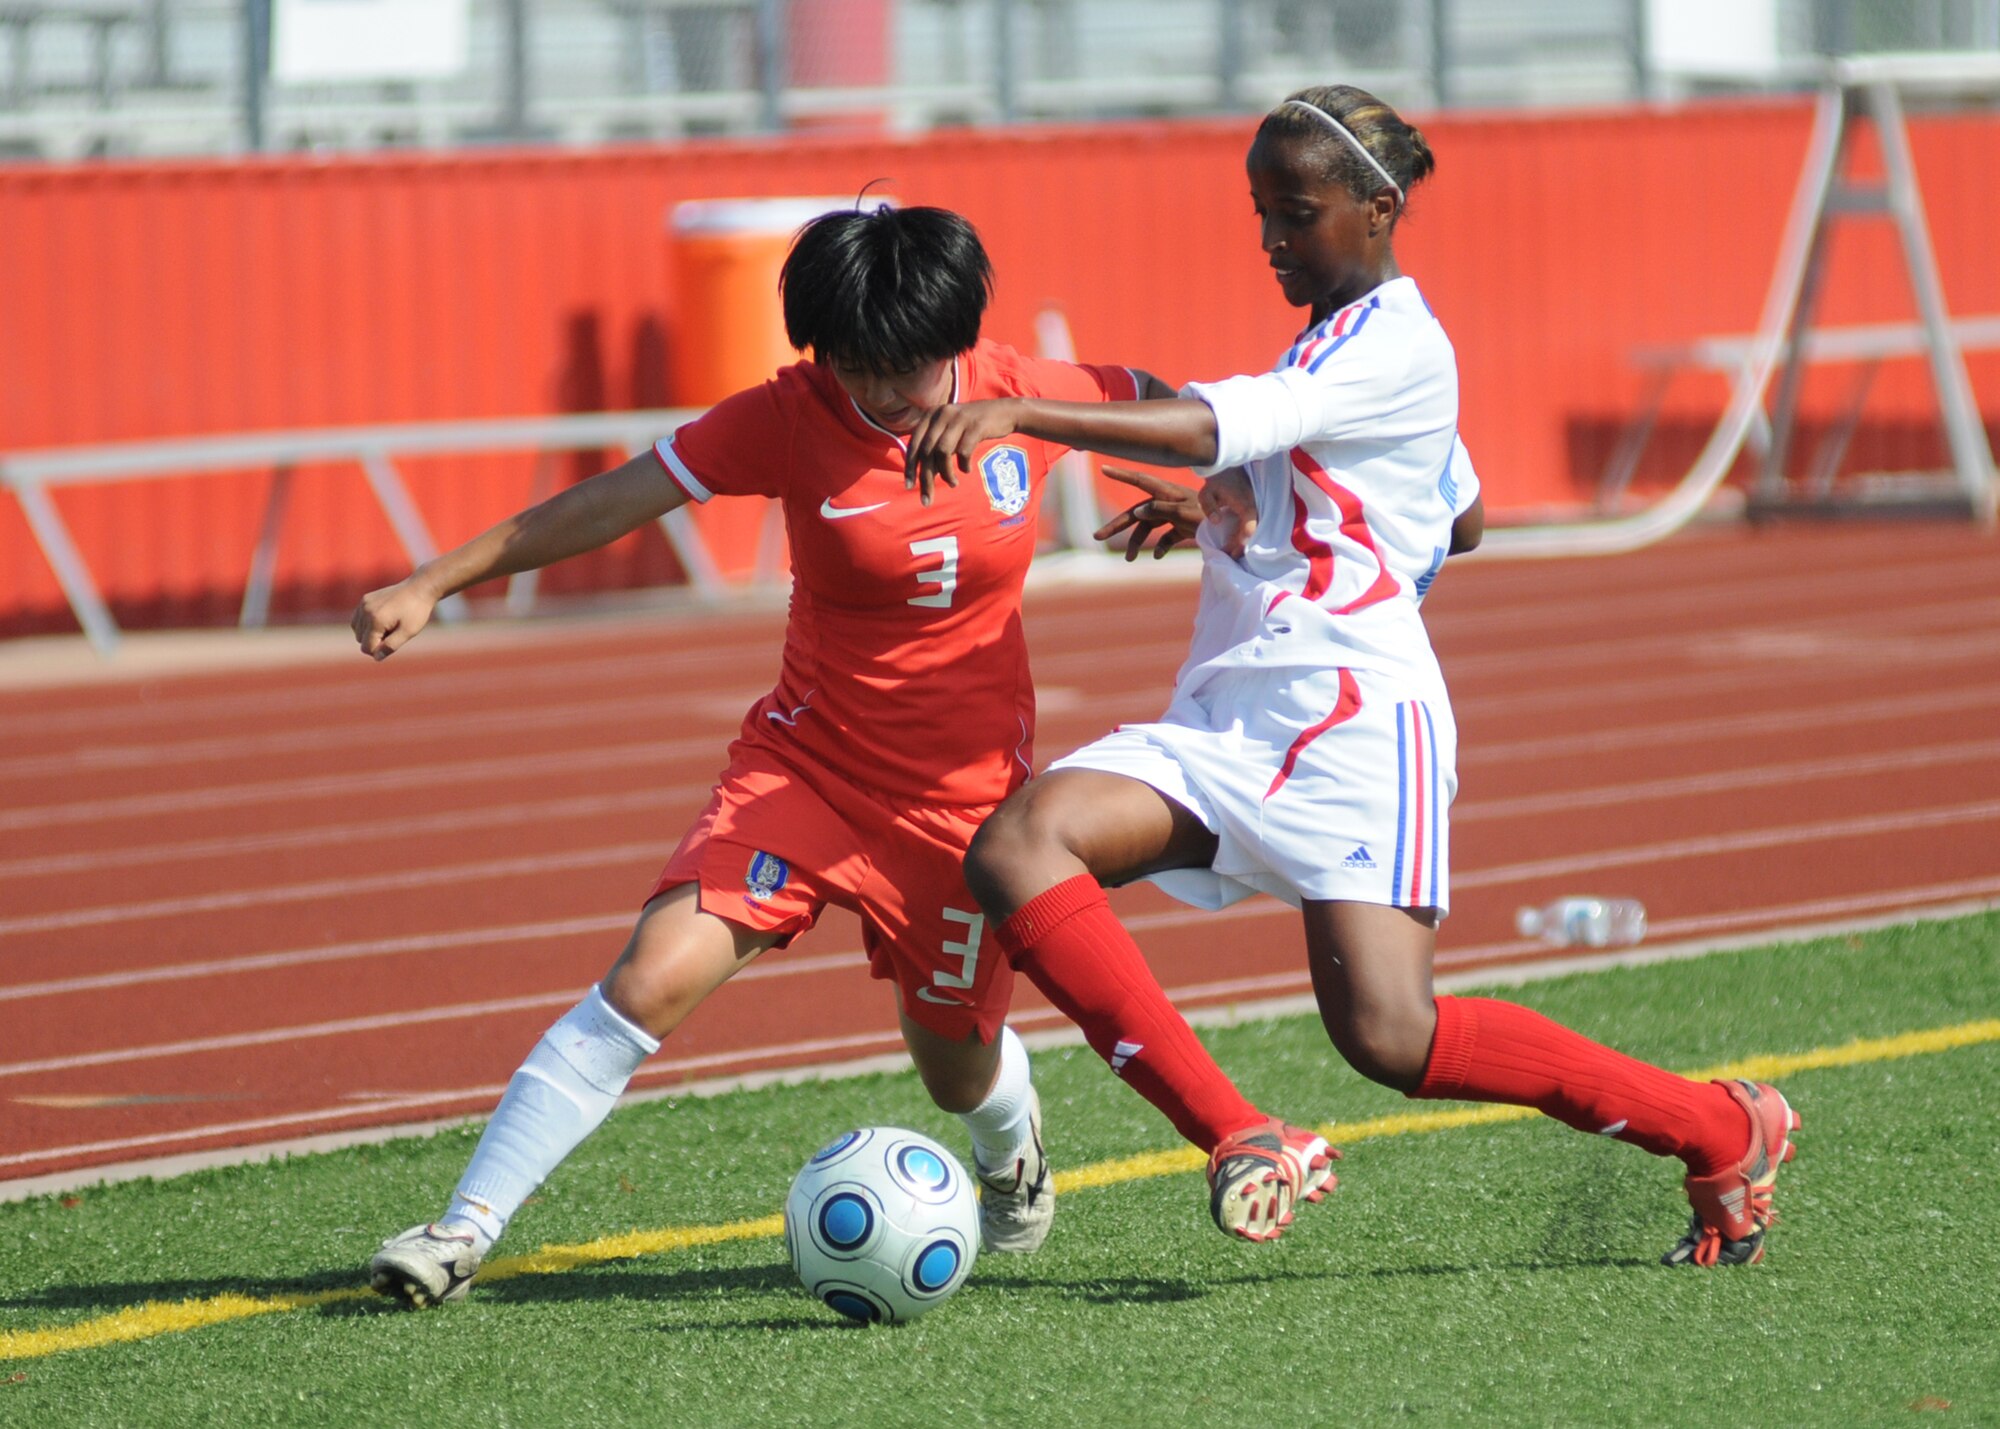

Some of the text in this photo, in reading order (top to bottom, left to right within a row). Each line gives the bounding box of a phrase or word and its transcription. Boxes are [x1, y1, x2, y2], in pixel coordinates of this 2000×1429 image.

[907, 535, 959, 608] 3
[1340, 859, 1377, 869] adidas
[933, 907, 984, 989] 3
